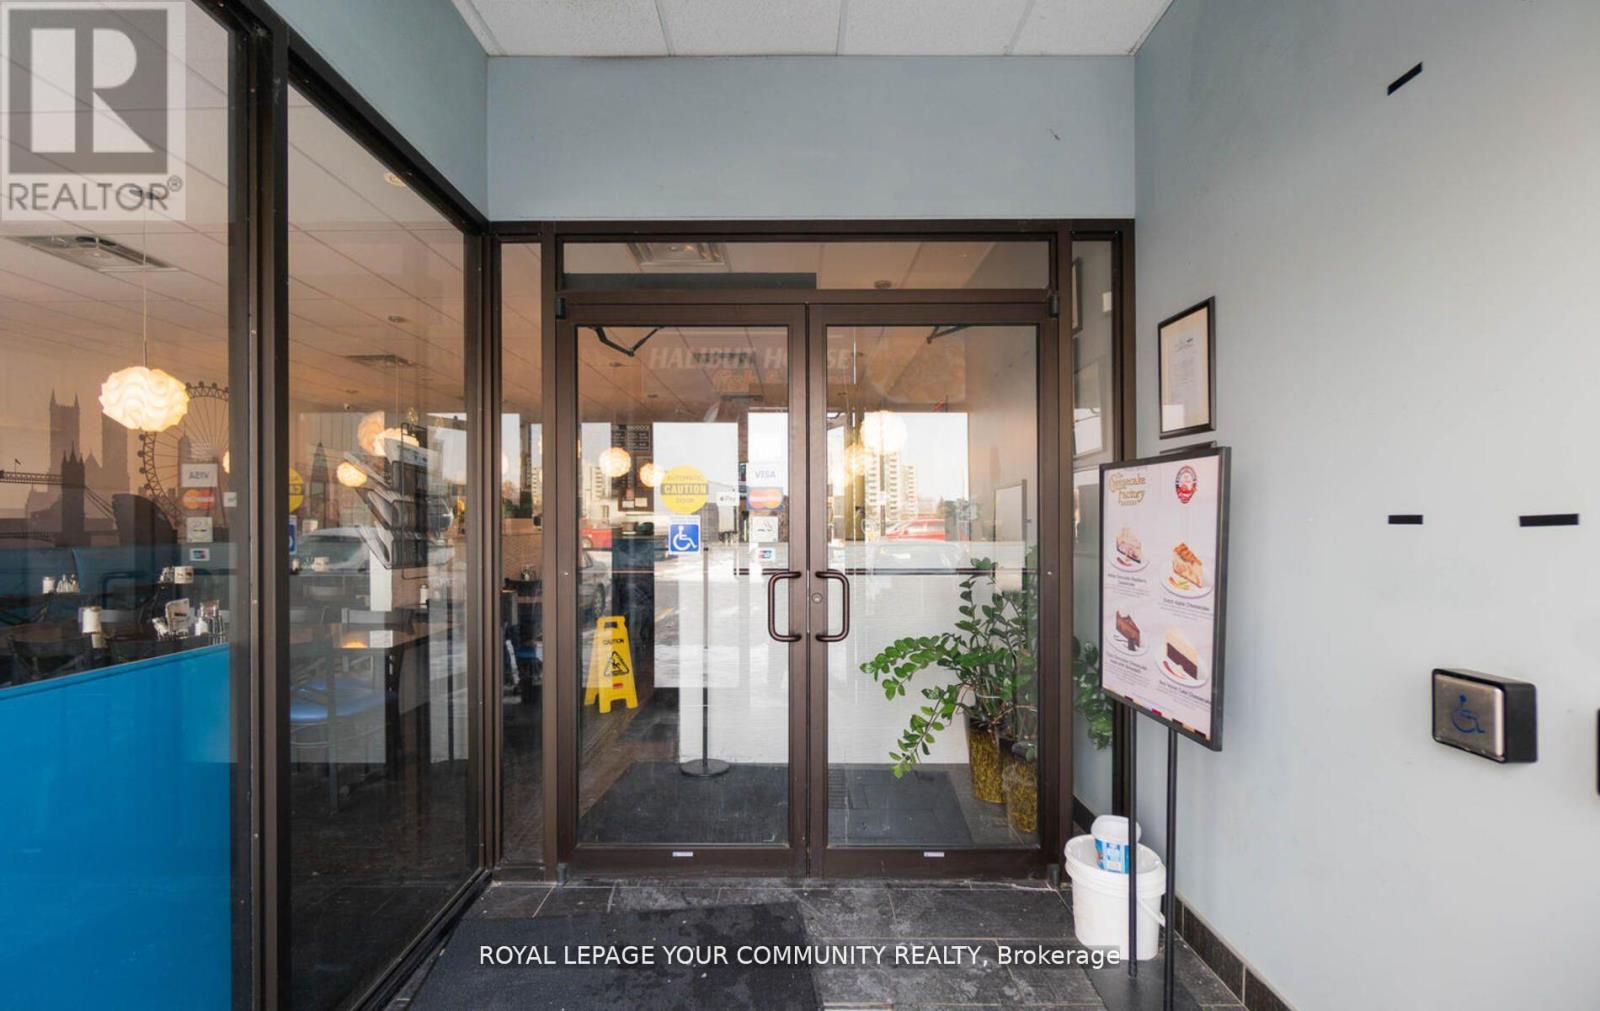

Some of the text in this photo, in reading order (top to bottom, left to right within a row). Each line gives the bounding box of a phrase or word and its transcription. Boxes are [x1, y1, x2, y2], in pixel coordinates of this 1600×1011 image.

[764, 347, 850, 369] HSE
[754, 470, 776, 479] VISA
[664, 484, 707, 495] CAUTION
